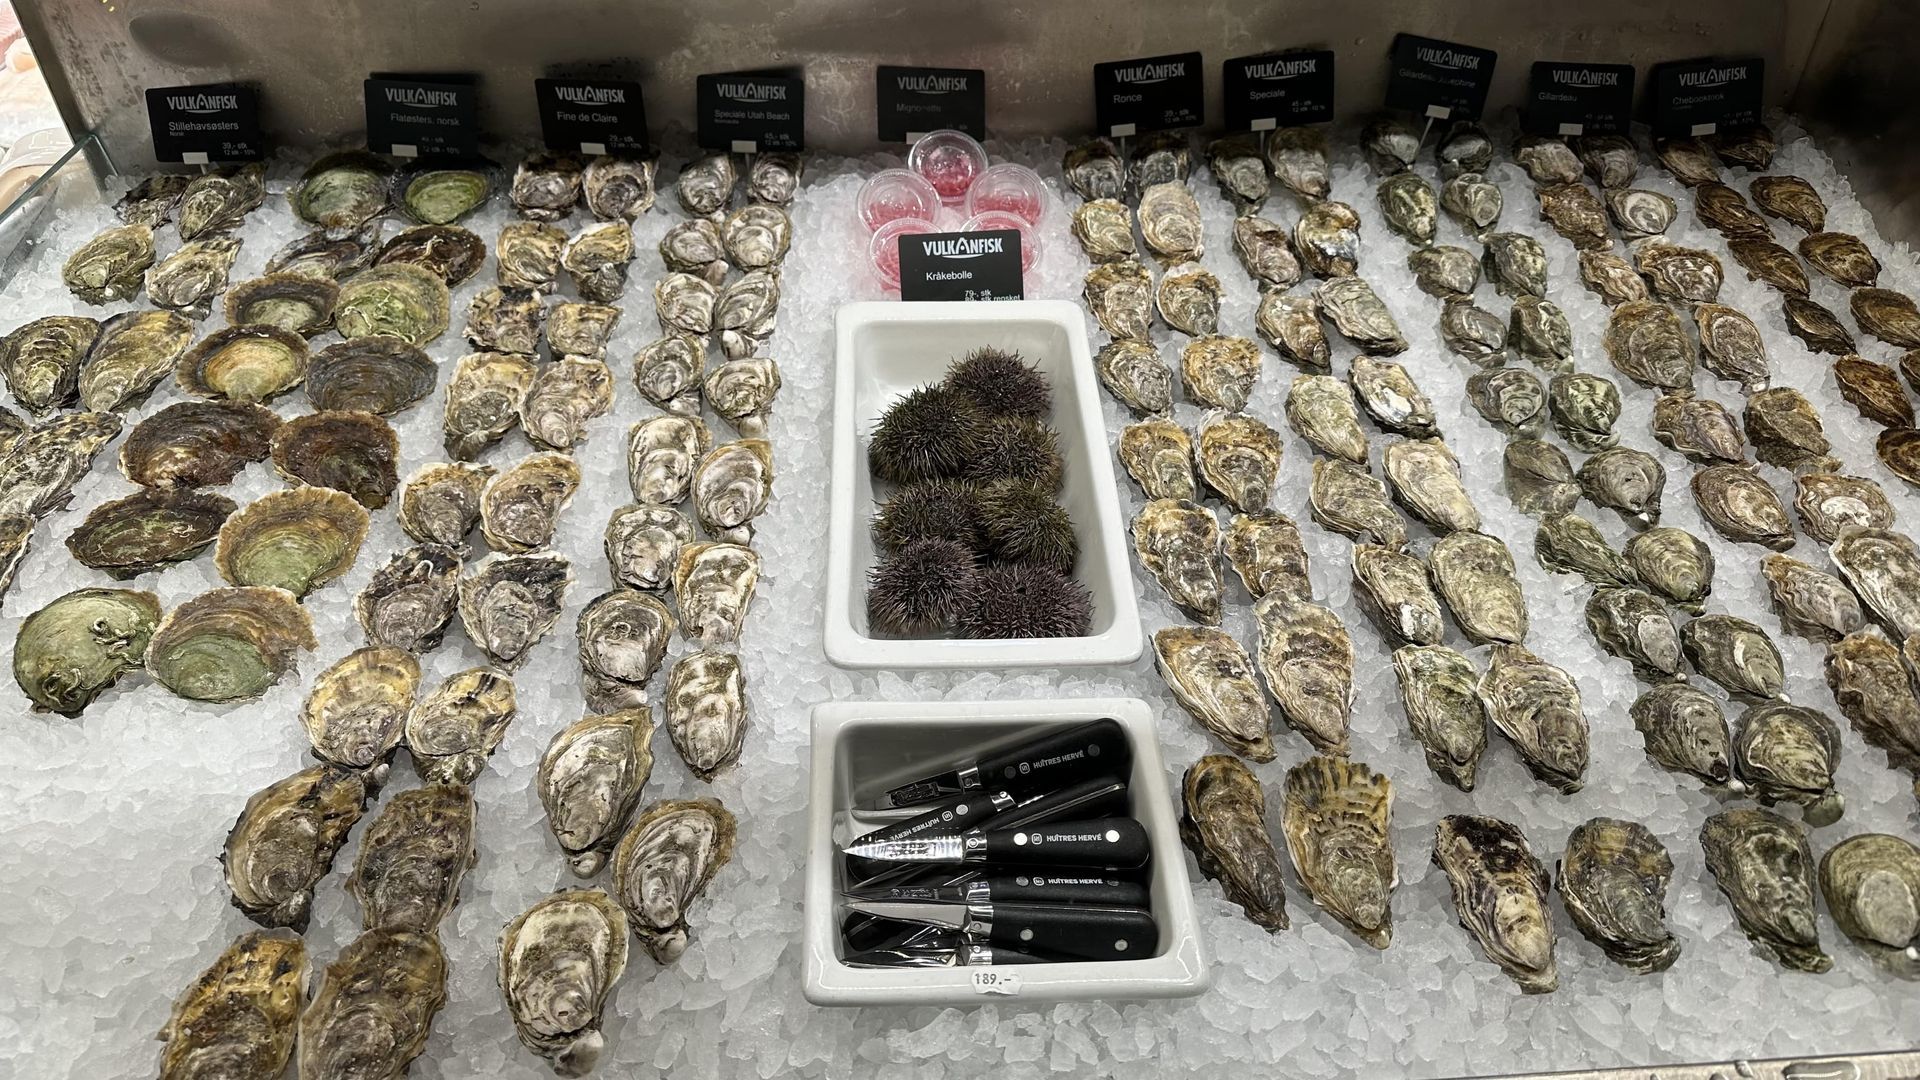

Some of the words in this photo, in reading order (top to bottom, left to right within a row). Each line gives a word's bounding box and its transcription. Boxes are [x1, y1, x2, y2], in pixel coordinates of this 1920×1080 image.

[1416, 47, 1481, 70] VULKANFISK
[1114, 63, 1185, 83] VULKANFISK
[1244, 59, 1317, 79] VULKANFISK
[1553, 69, 1618, 86] VULKANFISK
[1679, 66, 1747, 87] VULKANFISK
[716, 83, 786, 101] VULKANFISK
[897, 75, 968, 92] VULKANFISK
[166, 93, 239, 111] VULKANFISK
[385, 87, 458, 107] VULKANFISK
[554, 86, 626, 104] VULKANFISK
[1113, 94, 1143, 104] Ronce
[1249, 89, 1286, 101] Speciale
[557, 111, 577, 121] Fine
[578, 113, 590, 122] de
[592, 113, 618, 124] Claire
[766, 112, 790, 121] Beach
[168, 121, 239, 131] Stillehavsøsters
[922, 237, 1004, 256] VULKANFISK
[926, 271, 973, 281] Kråkebolle
[981, 289, 992, 297] stk
[1033, 758, 1061, 769] HUÎTRES
[1061, 749, 1084, 762] HERVÉ
[1046, 833, 1077, 842] HUÎTRES
[1078, 832, 1102, 841] HERVÉ
[975, 973, 1012, 985] 189.-
